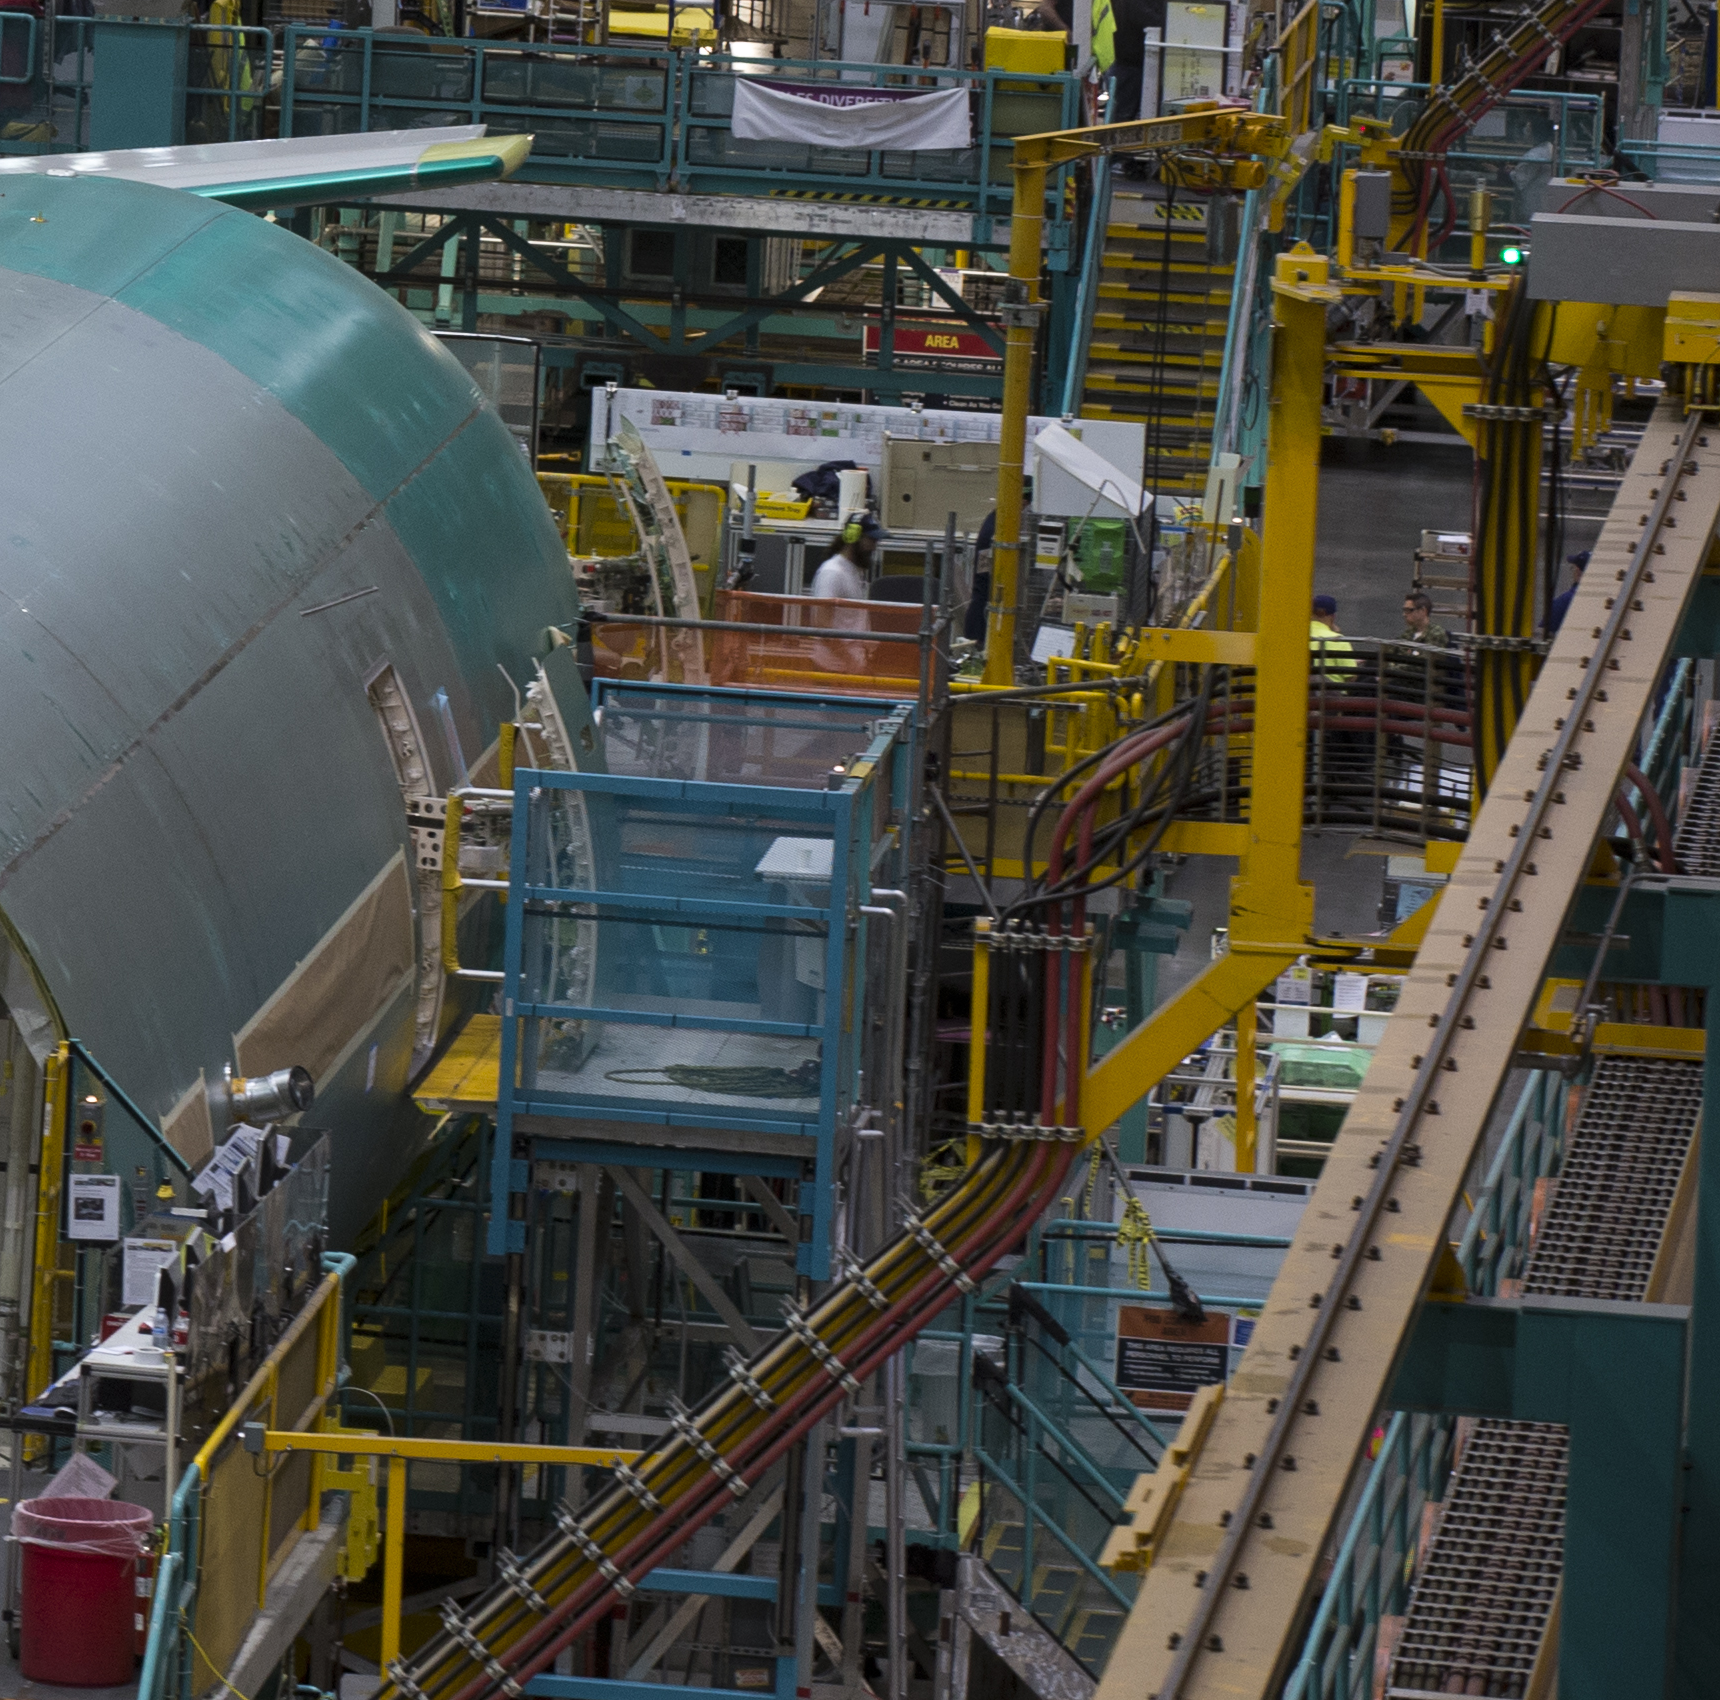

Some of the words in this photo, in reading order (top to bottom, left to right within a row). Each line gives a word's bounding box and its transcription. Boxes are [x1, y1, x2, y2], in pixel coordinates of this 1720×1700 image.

[924, 334, 960, 349] AREA
[1145, 1343, 1165, 1351] AREA
[1166, 1344, 1204, 1354] REQUIRES
